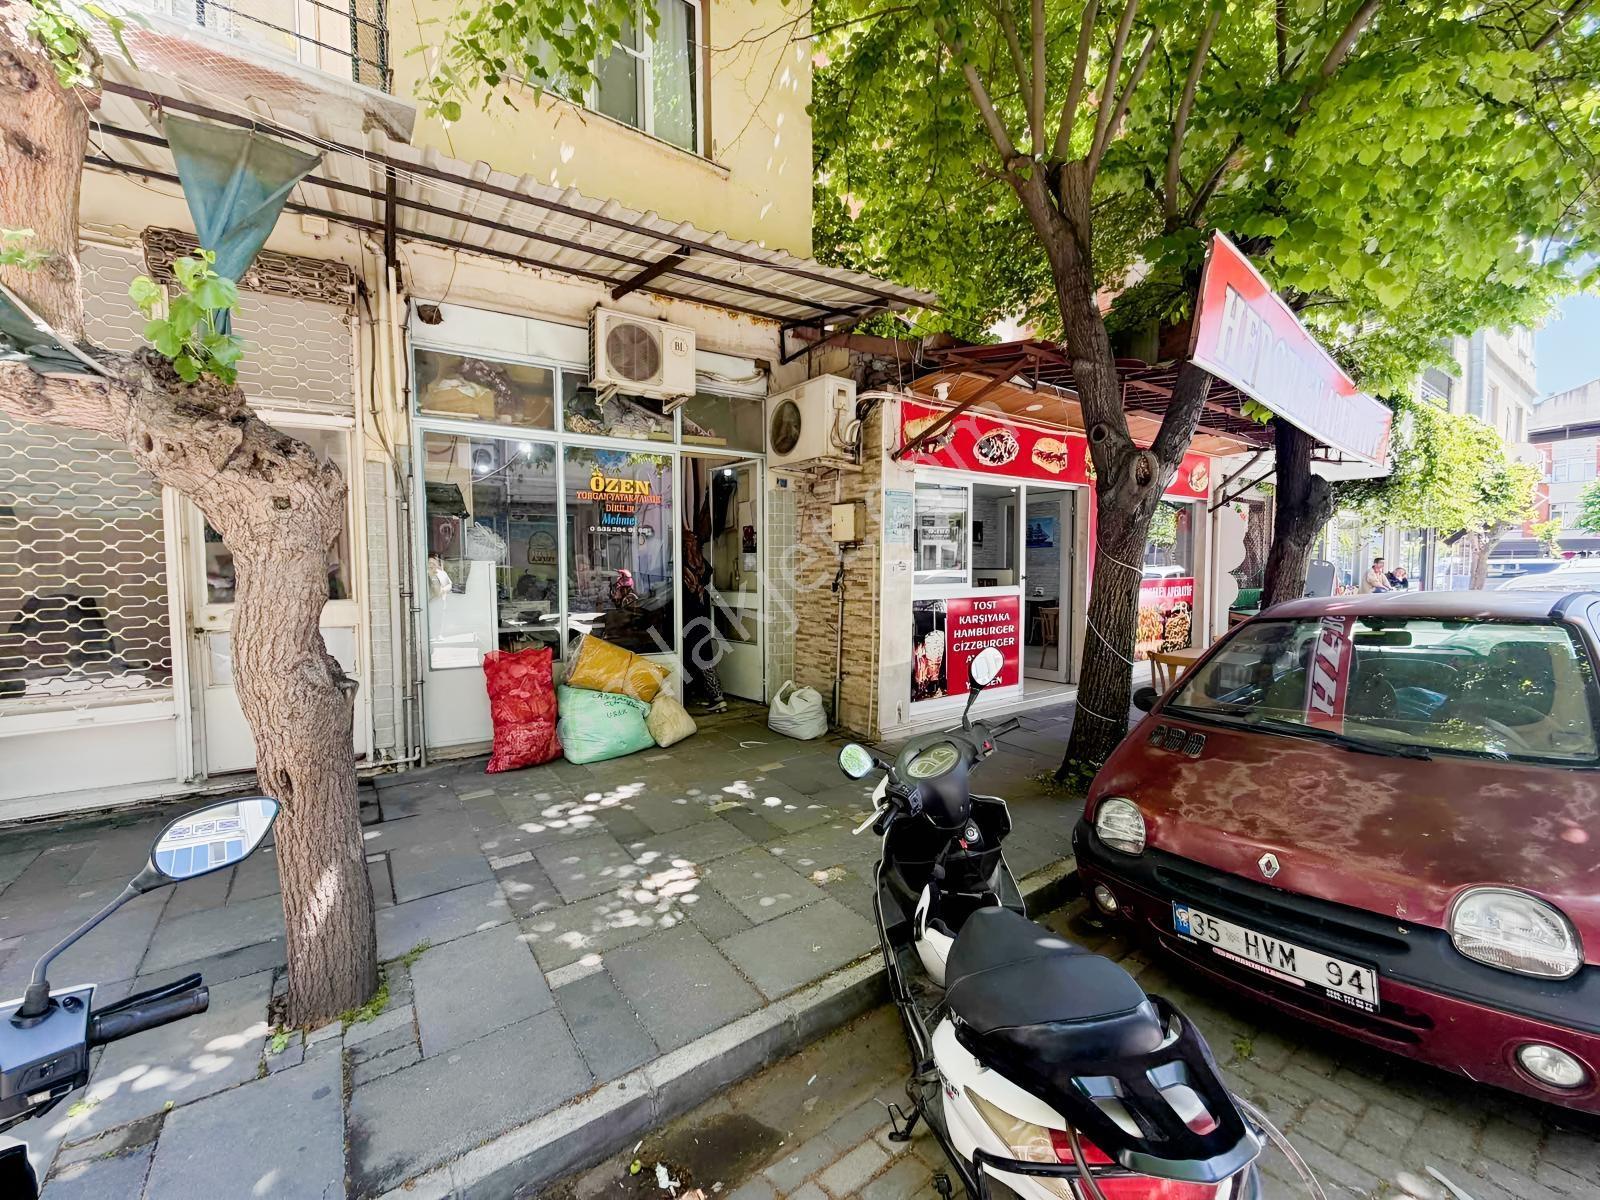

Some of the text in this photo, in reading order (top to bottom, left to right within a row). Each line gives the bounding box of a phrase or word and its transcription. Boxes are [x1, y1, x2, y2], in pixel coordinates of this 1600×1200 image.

[590, 472, 650, 495] ÖZEN
[973, 601, 997, 611] TOST
[959, 613, 1010, 625] KARŞIYAKA
[953, 625, 1015, 638] HAMBURGER
[1192, 914, 1220, 943] 35
[1244, 931, 1297, 973] HVM
[1325, 961, 1365, 995] 94
